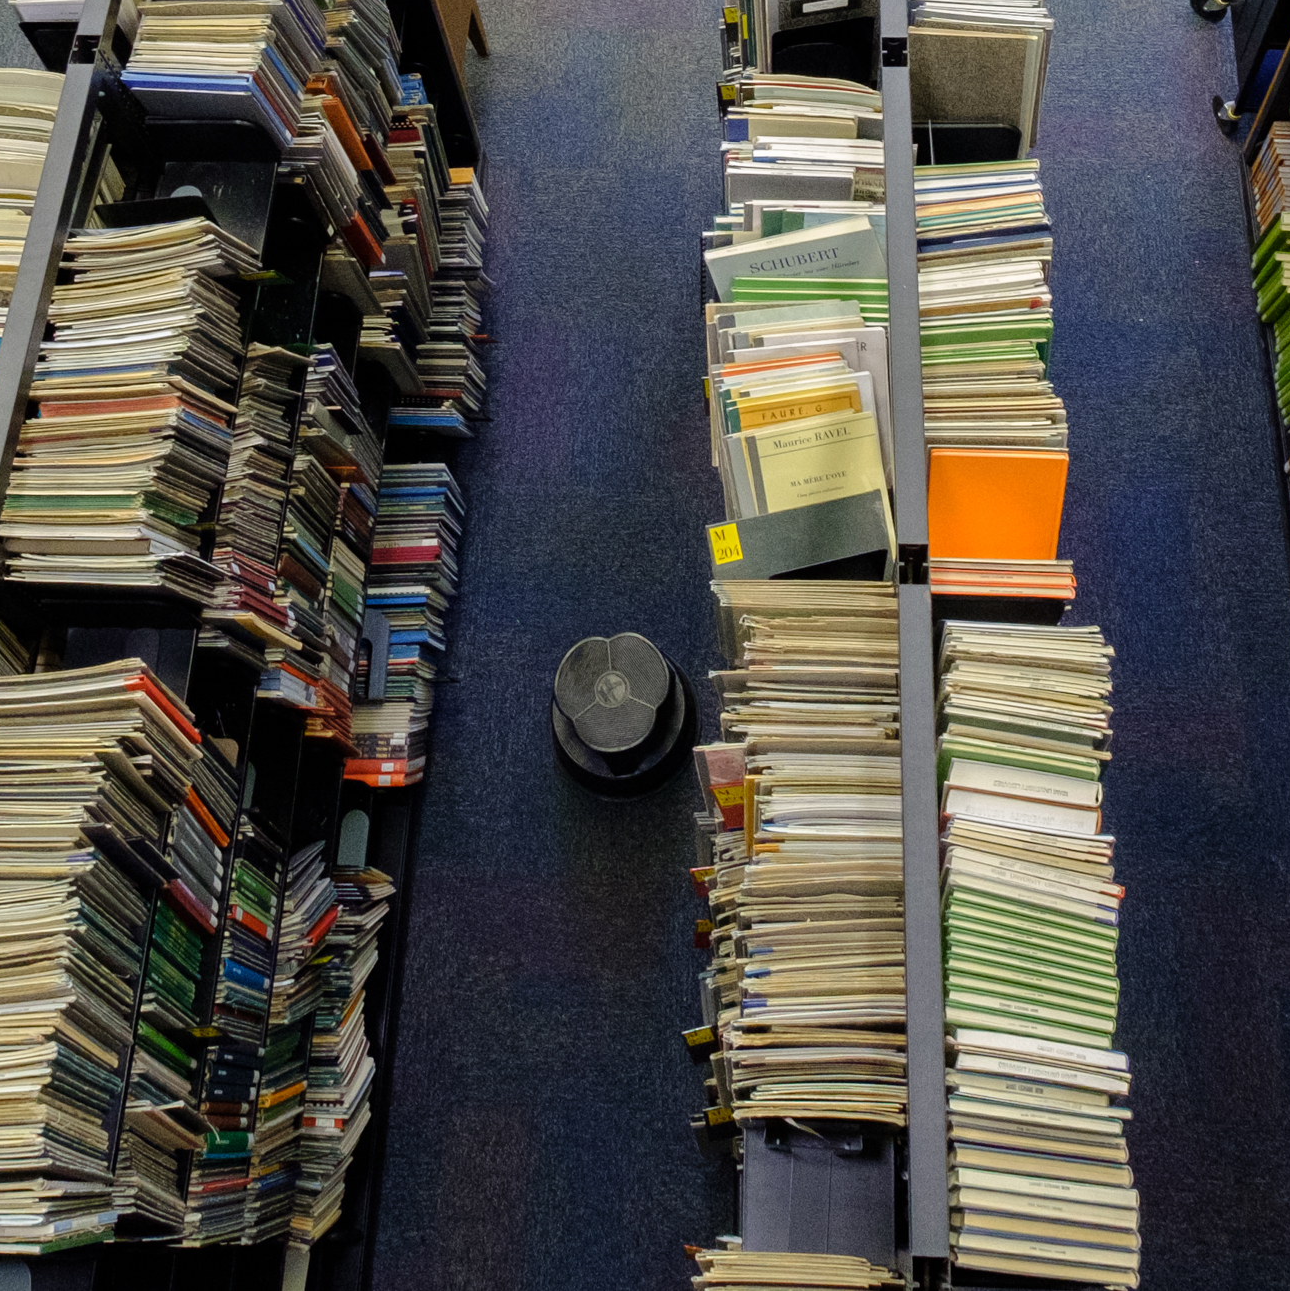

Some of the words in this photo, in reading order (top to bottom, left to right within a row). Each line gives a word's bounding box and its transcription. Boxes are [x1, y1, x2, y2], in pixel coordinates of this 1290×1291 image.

[749, 247, 839, 274] SCHUBERT
[773, 436, 813, 451] Maurice
[814, 426, 852, 443] RAVEL
[790, 480, 802, 488] MA
[803, 474, 825, 486] MÈRE
[825, 470, 847, 482] L'OYE
[713, 530, 727, 542] M
[716, 546, 741, 561] 204
